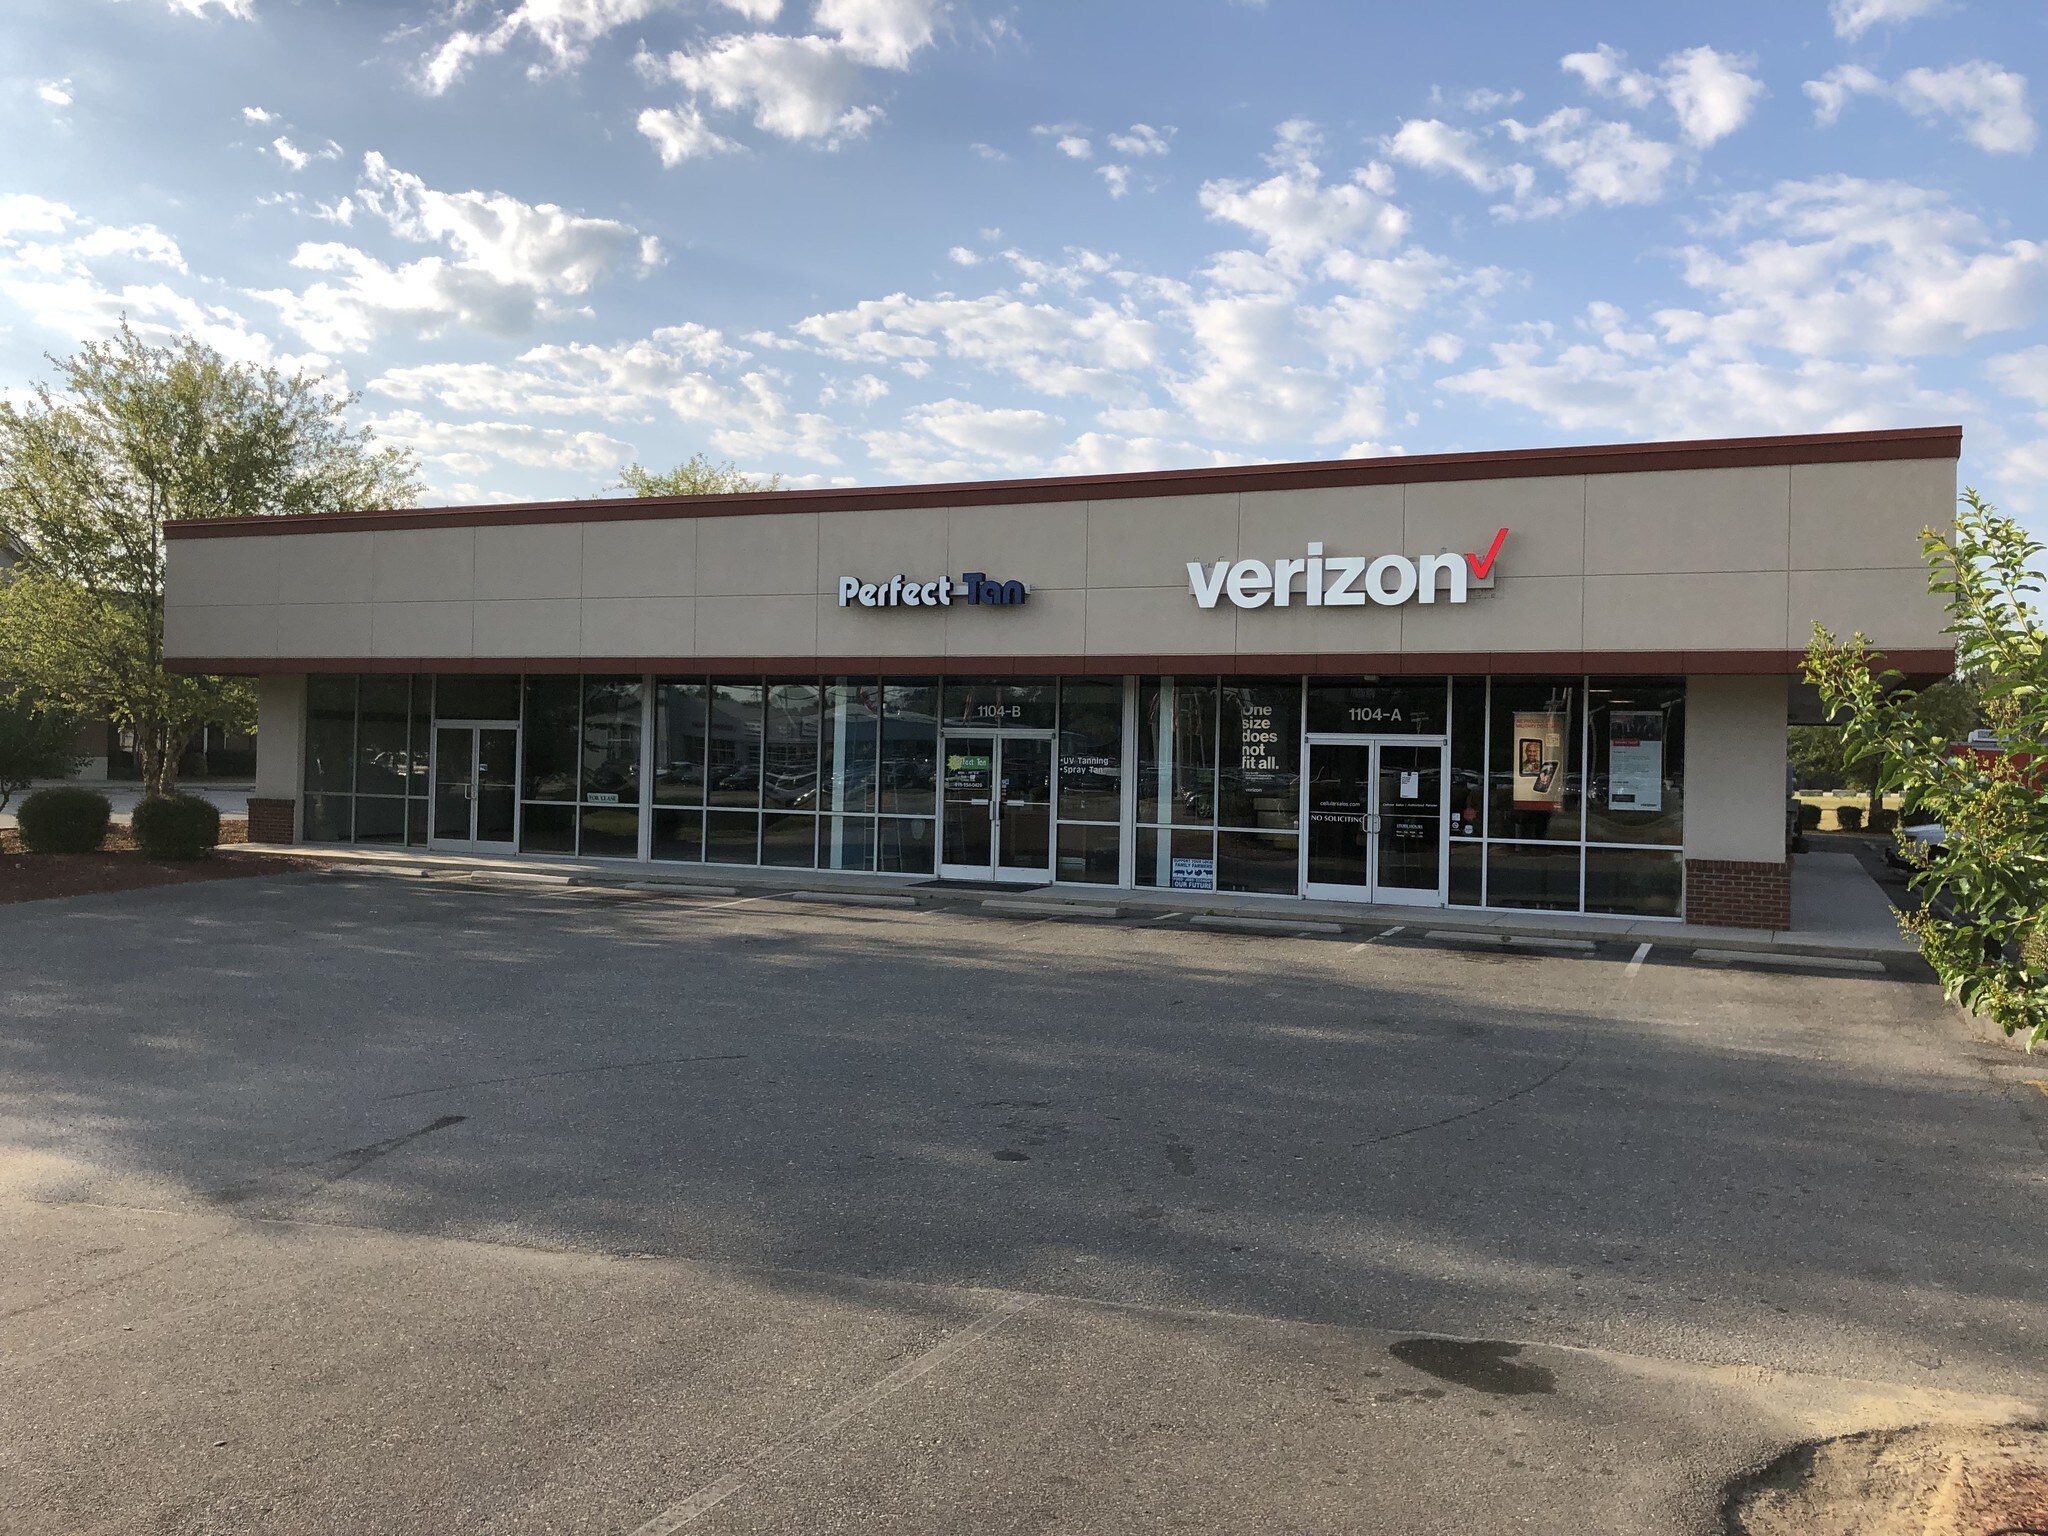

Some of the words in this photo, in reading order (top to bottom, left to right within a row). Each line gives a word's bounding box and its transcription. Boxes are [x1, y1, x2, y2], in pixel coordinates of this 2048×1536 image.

[1186, 541, 1467, 609] verizon
[838, 573, 952, 607] Perfect
[962, 571, 1026, 606] Tan
[977, 705, 1021, 718] 1104-B
[1242, 704, 1273, 716] One
[1348, 707, 1402, 721] 1104-A
[1242, 716, 1271, 729] size
[1242, 729, 1278, 743] does
[1242, 743, 1266, 756] not
[1077, 757, 1109, 766] Tanning
[1241, 756, 1256, 769] fit
[1258, 756, 1280, 770] all.
[1063, 766, 1086, 775] Spray
[1088, 766, 1104, 774] Tan
[1174, 880, 1188, 888] OUR
[1188, 881, 1212, 889] FUTURE
